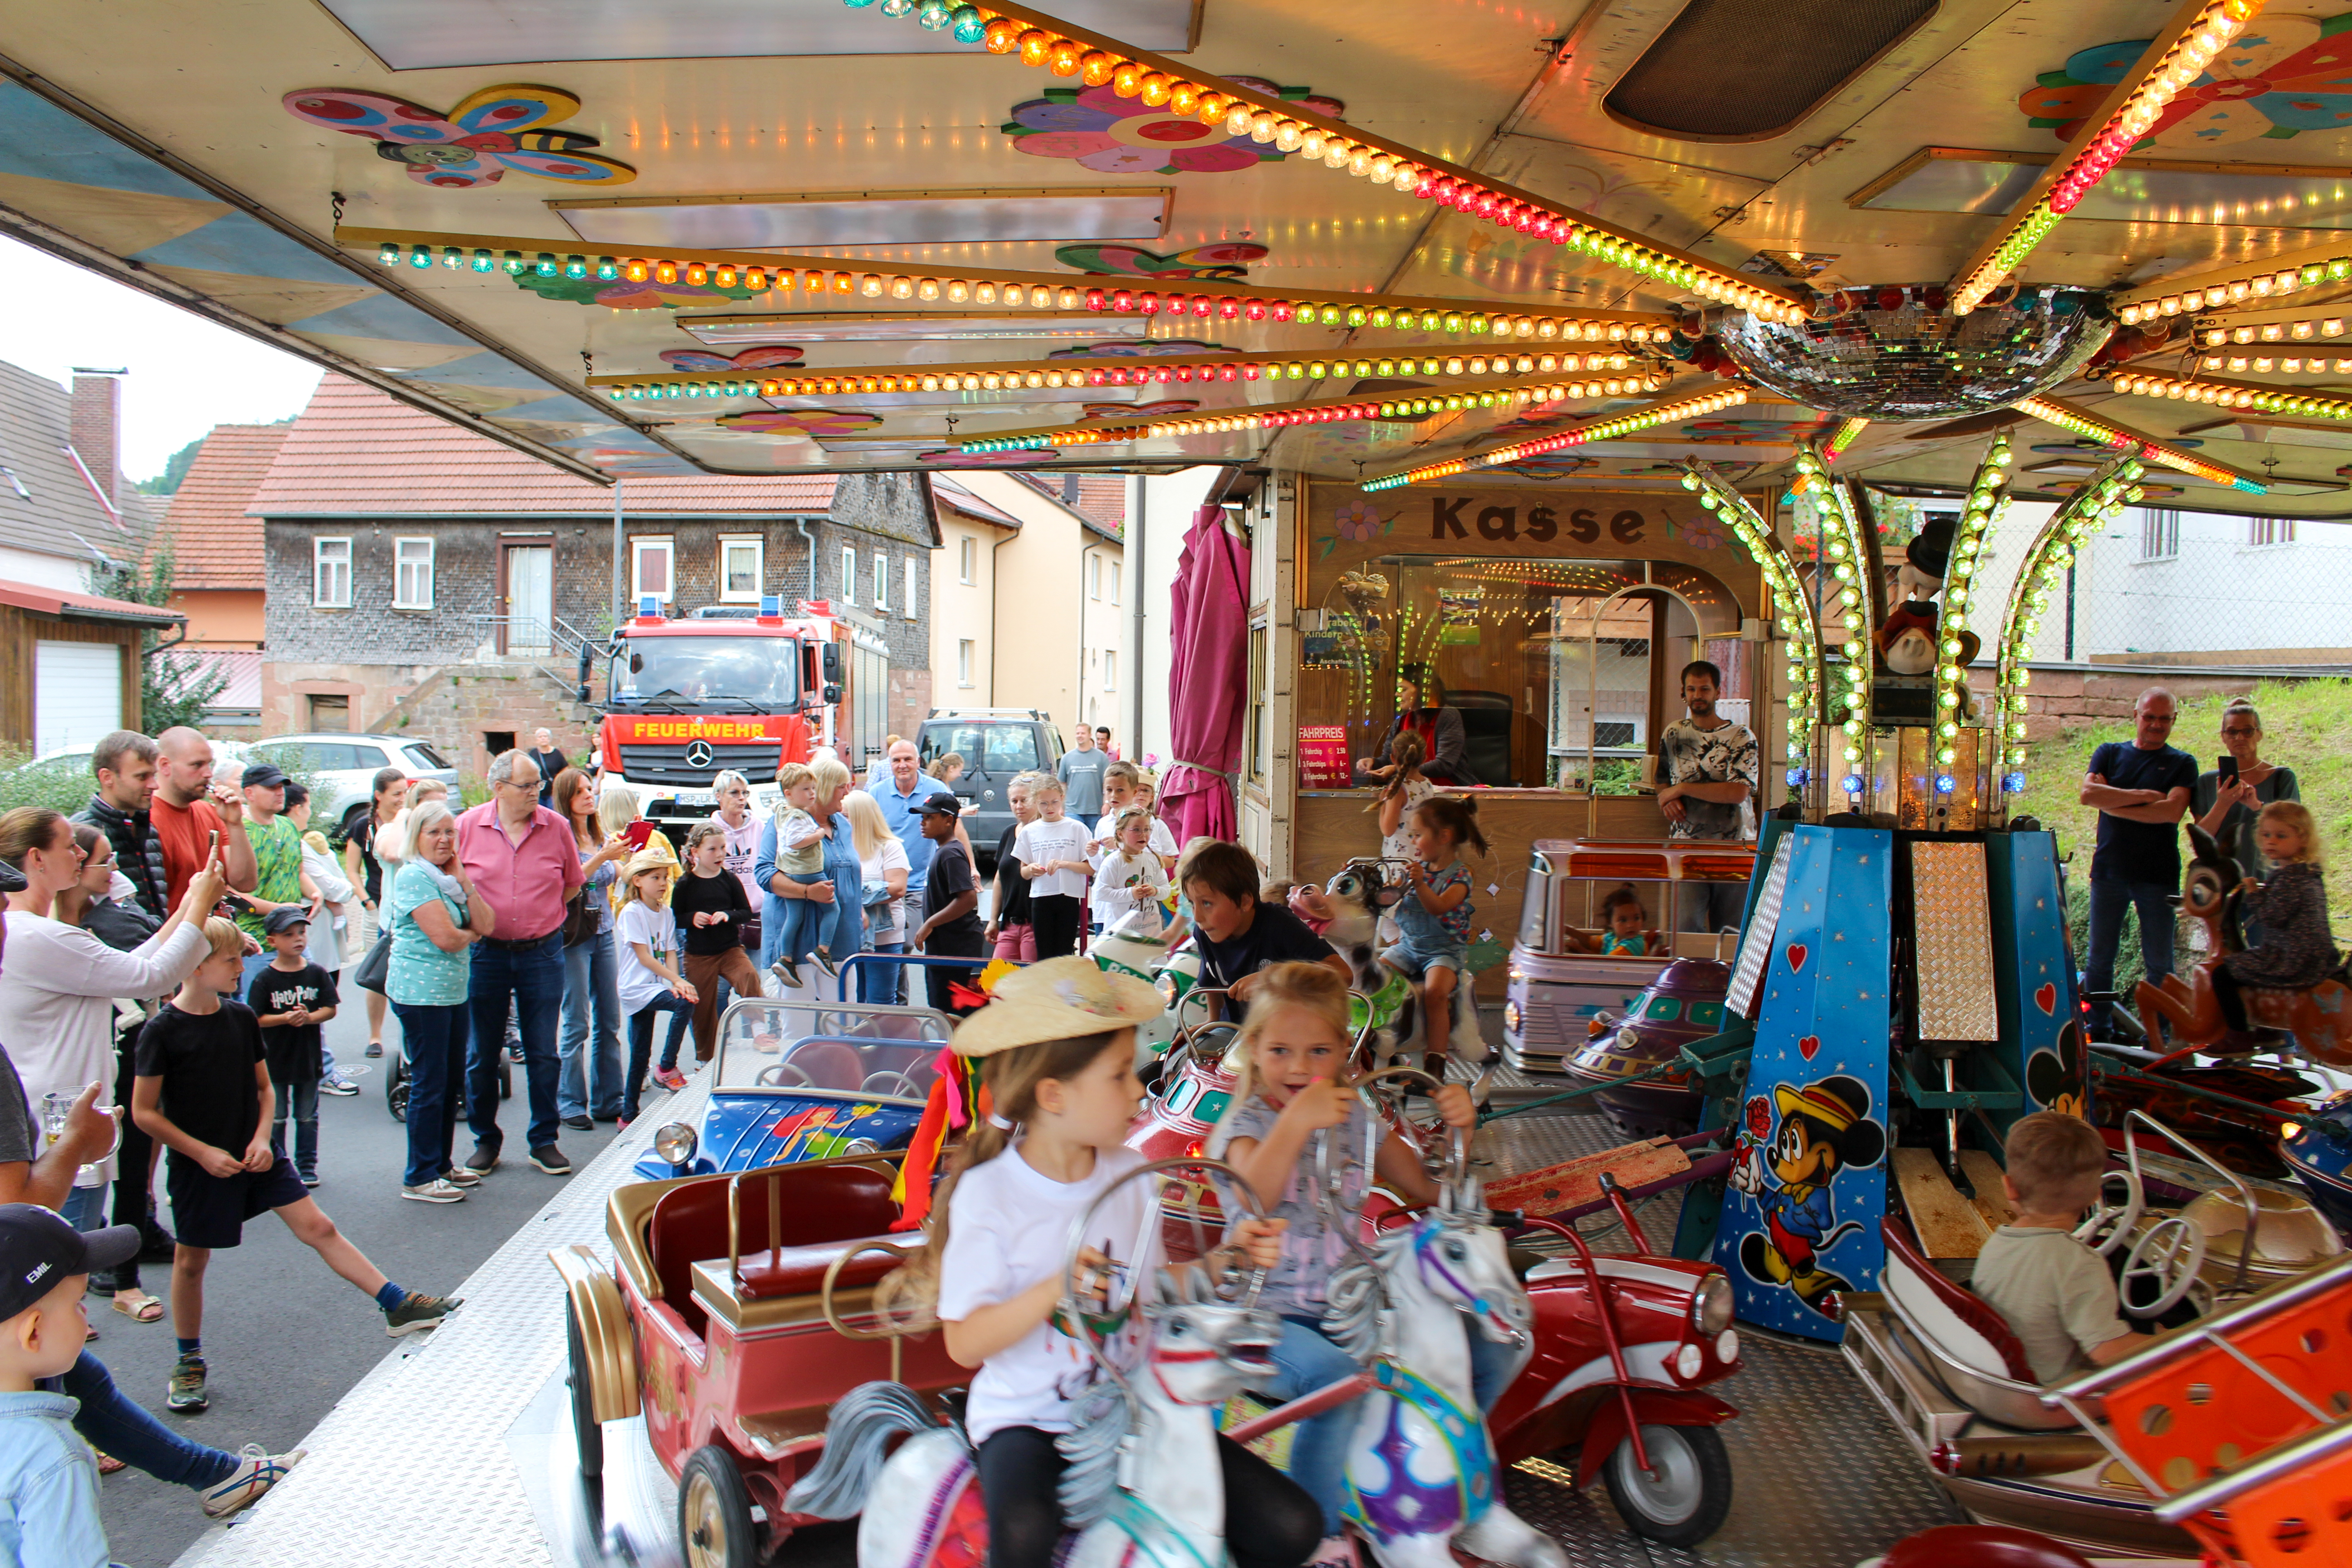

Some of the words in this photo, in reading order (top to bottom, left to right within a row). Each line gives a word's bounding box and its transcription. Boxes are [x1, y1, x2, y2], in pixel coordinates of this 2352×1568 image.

[1431, 497, 1646, 544] Kasse
[634, 723, 765, 737] FEUERWEHR
[1298, 727, 1344, 739] FAHRPREIS
[1305, 748, 1323, 756] Fahrchip
[1306, 760, 1327, 769] Fahrchips
[727, 866, 753, 874] didas
[270, 990, 298, 1009] Harry
[294, 985, 319, 1005] Potter
[26, 1262, 53, 1284] EMIL
